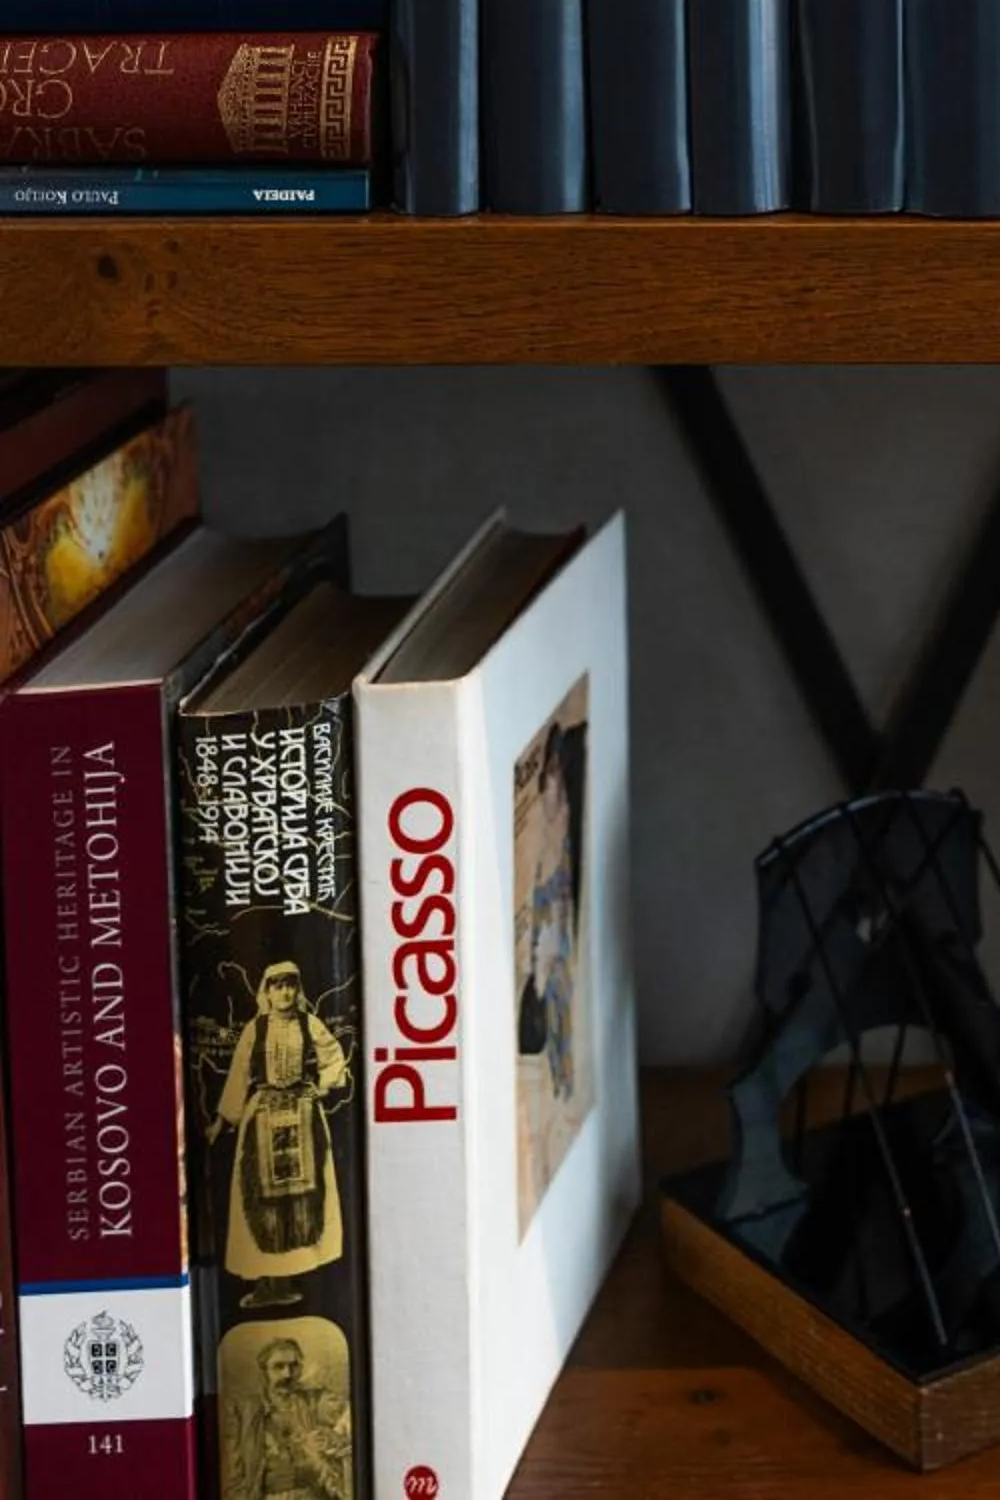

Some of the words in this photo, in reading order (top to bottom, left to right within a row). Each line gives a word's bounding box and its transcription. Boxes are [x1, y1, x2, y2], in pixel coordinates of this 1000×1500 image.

[0, 36, 175, 76] TRAGE
[0, 78, 74, 120] GR
[252, 188, 316, 201] PAIDEIA
[50, 746, 73, 777] IN
[221, 733, 247, 750] И
[249, 731, 276, 750] У
[279, 727, 308, 850] ИСТОРИЈА
[53, 789, 79, 941] HERITAGE
[83, 741, 126, 949] METOHIJA
[221, 755, 251, 906] СЛАВОНИЈИ
[250, 753, 280, 897] ХРВАТСКОЈ
[283, 853, 310, 916] СРБА
[92, 962, 126, 1050] AND
[373, 787, 458, 1124] Picasso
[58, 955, 83, 1106] ARTISTIC
[65, 1124, 90, 1242] SERBIAN
[94, 1063, 133, 1237] KOSOVO
[87, 1433, 125, 1455] 141
